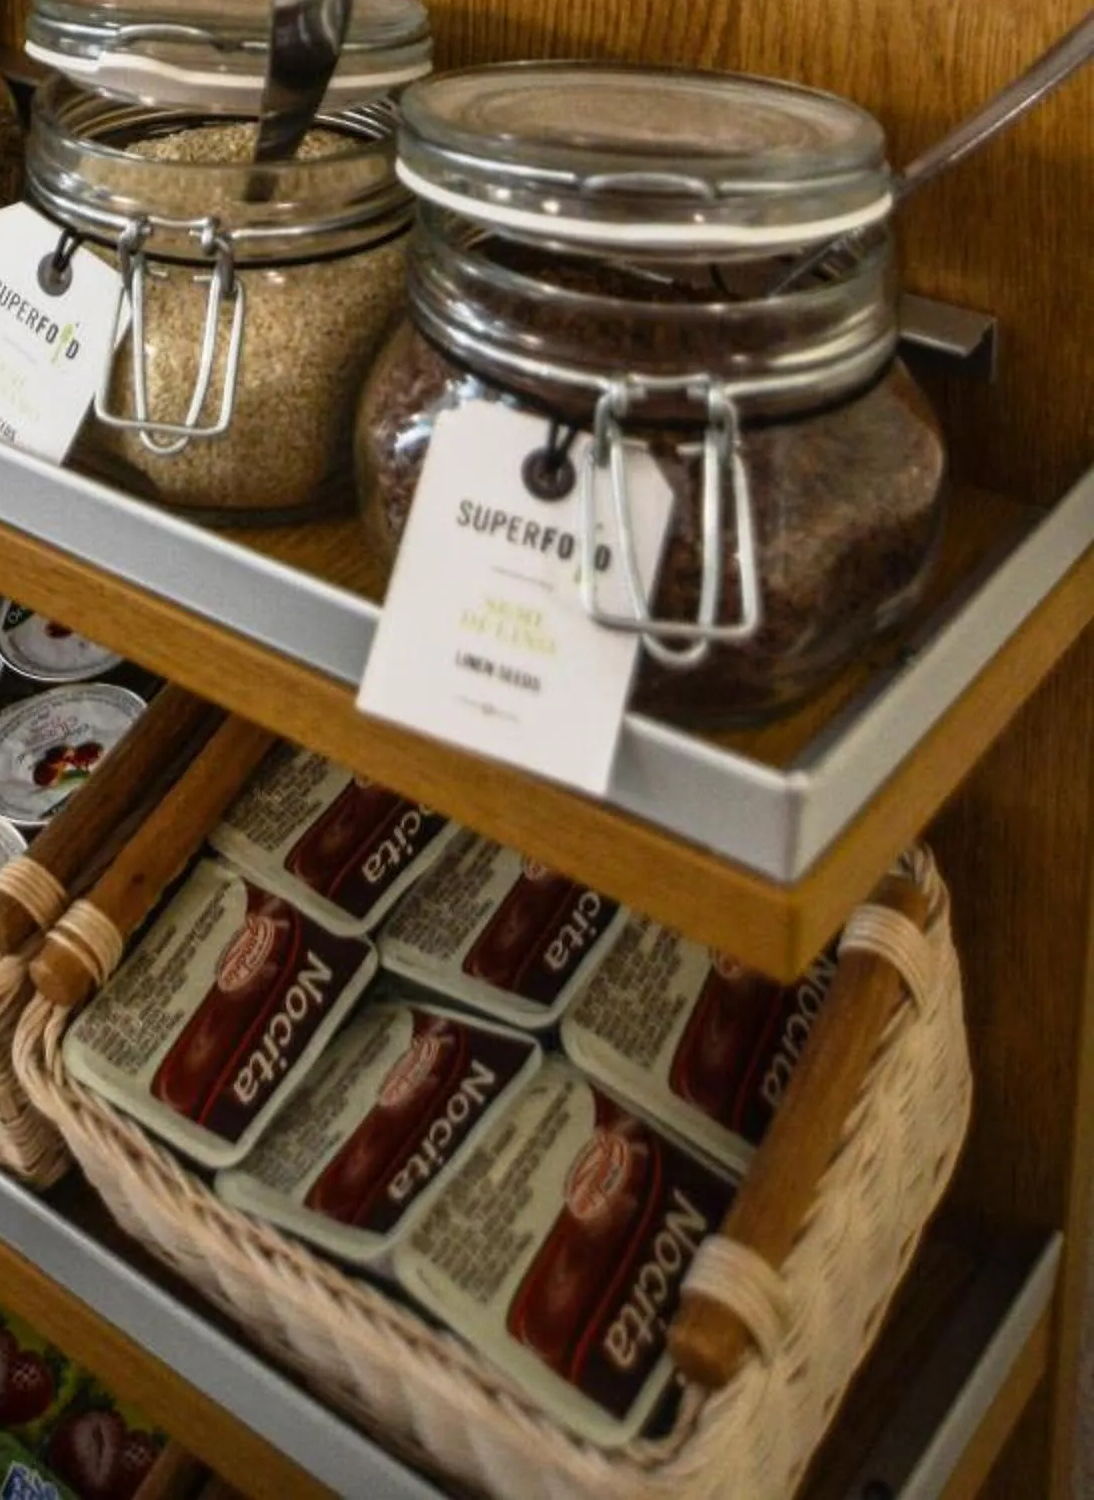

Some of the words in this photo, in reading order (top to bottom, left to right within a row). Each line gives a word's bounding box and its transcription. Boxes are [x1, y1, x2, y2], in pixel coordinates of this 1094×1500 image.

[456, 499, 613, 573] SUPERFOD
[361, 805, 436, 886] cita
[543, 889, 602, 972] cita
[233, 951, 334, 1105] Nocita
[386, 1057, 497, 1202] Nocita
[603, 1186, 709, 1370] Nocita
